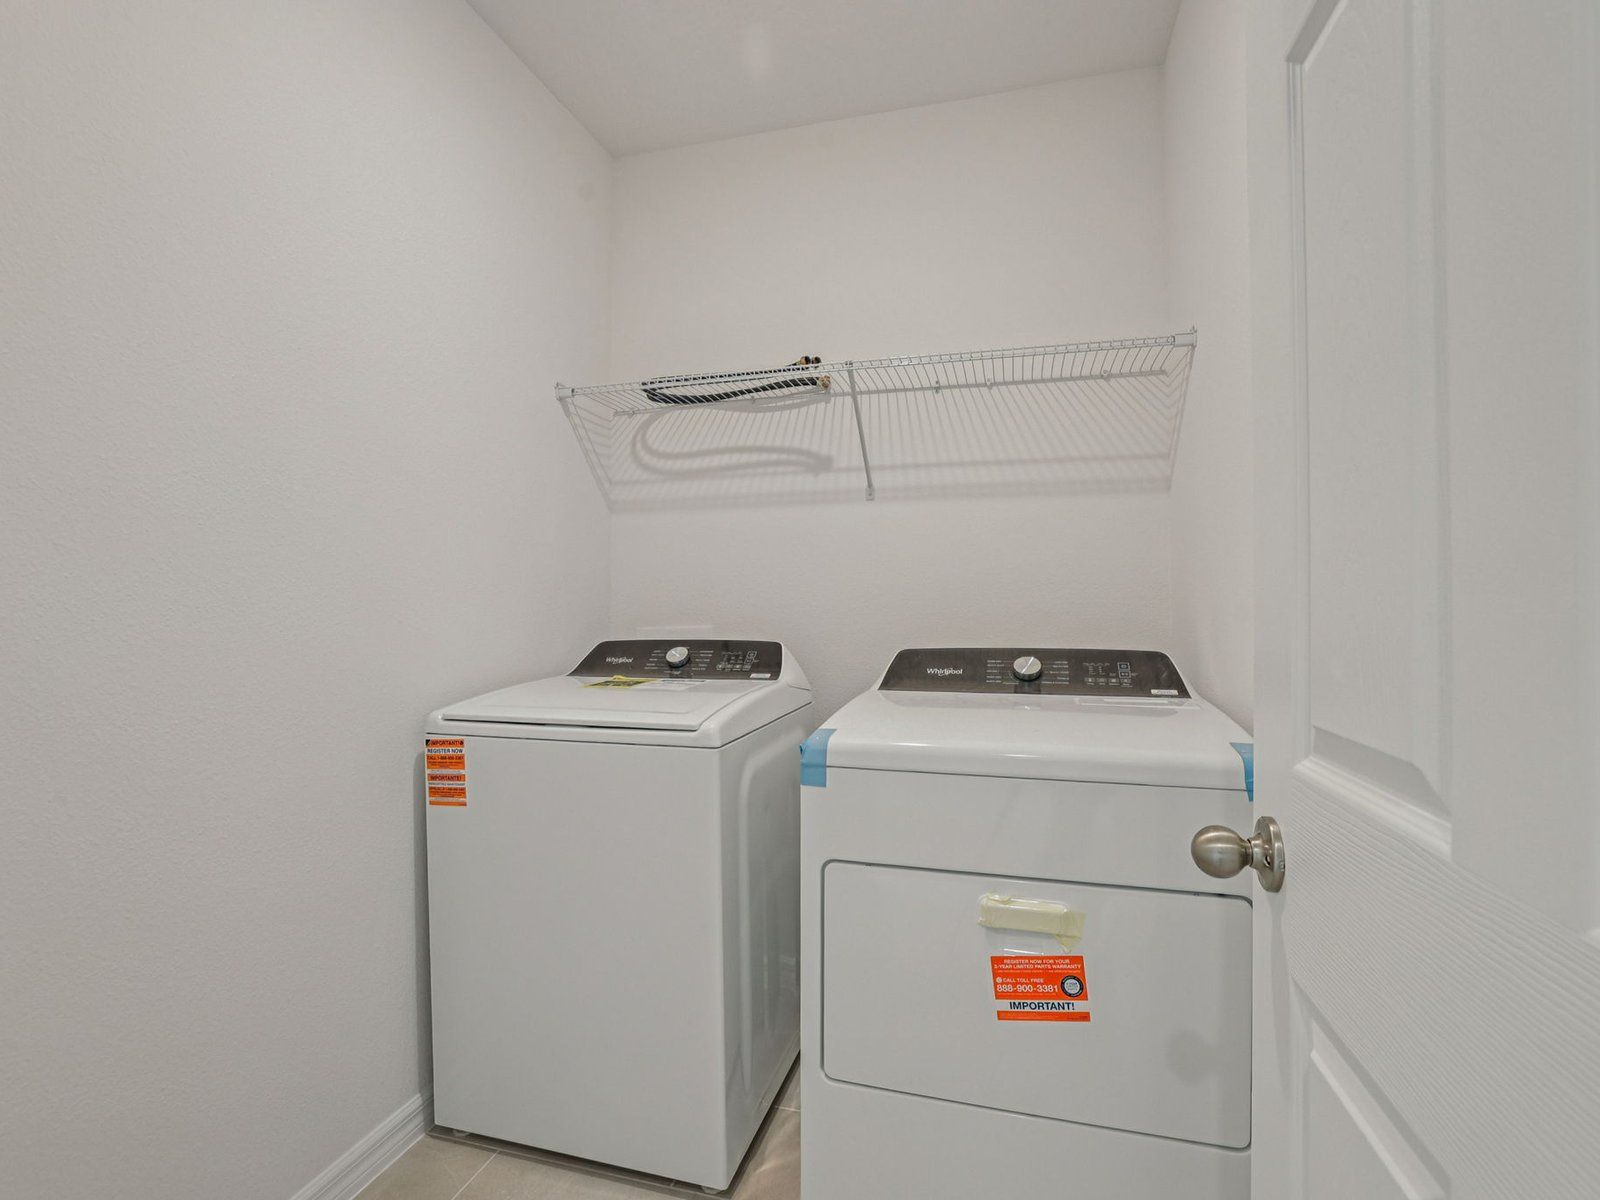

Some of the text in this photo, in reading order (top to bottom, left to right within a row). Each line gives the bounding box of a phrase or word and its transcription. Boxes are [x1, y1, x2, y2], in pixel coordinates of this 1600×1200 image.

[605, 656, 634, 665] Whirlpool
[926, 667, 963, 677] Whirlpool
[996, 984, 1059, 993] 888-900-3381
[1009, 1002, 1075, 1010] IMPORTANT!
